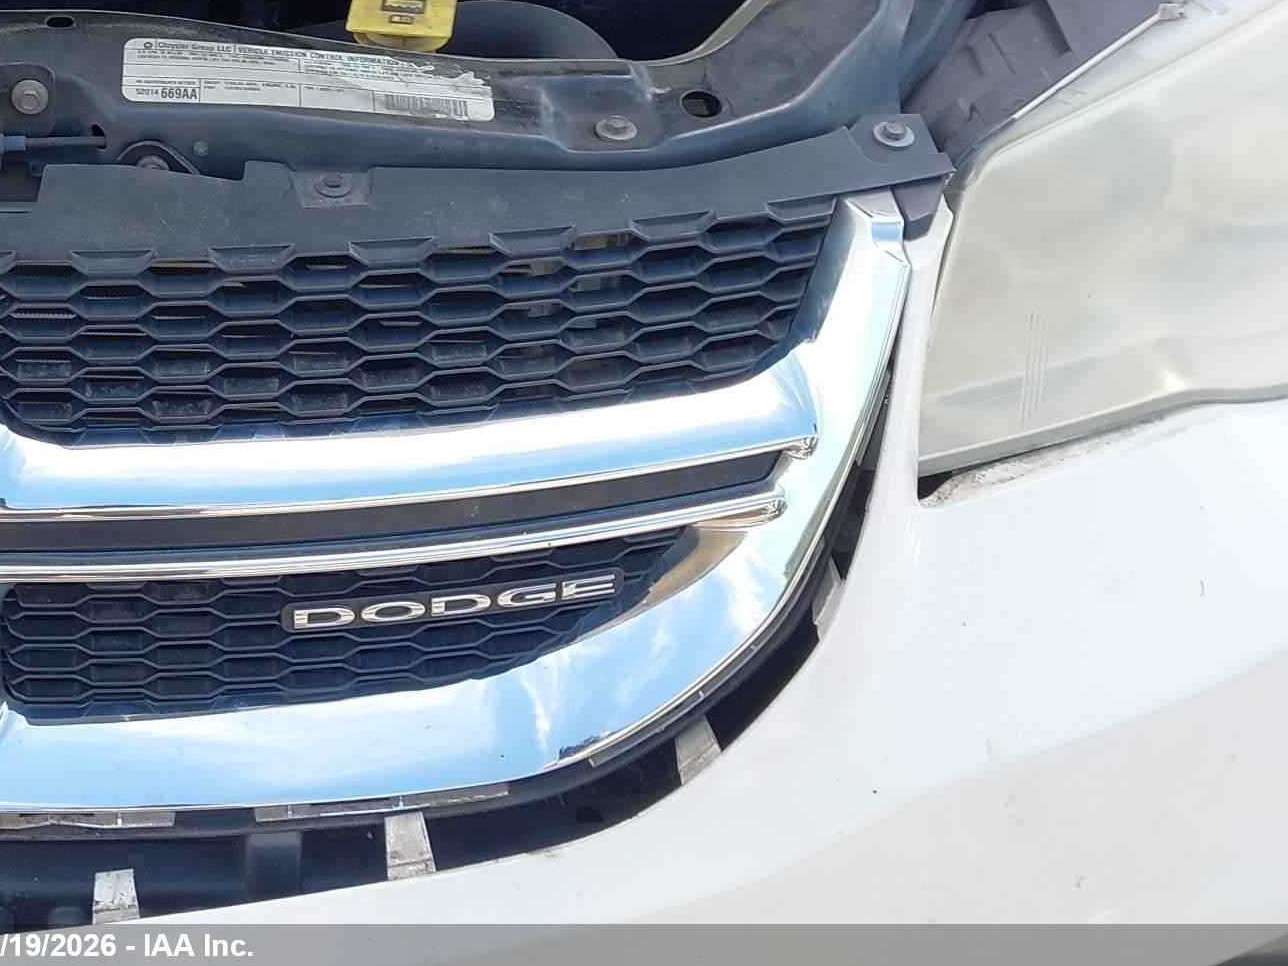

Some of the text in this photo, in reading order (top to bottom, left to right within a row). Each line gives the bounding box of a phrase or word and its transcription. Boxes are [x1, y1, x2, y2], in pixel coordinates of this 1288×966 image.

[217, 45, 232, 53] LLC
[161, 87, 198, 100] 669AA
[293, 574, 615, 629] DODGE
